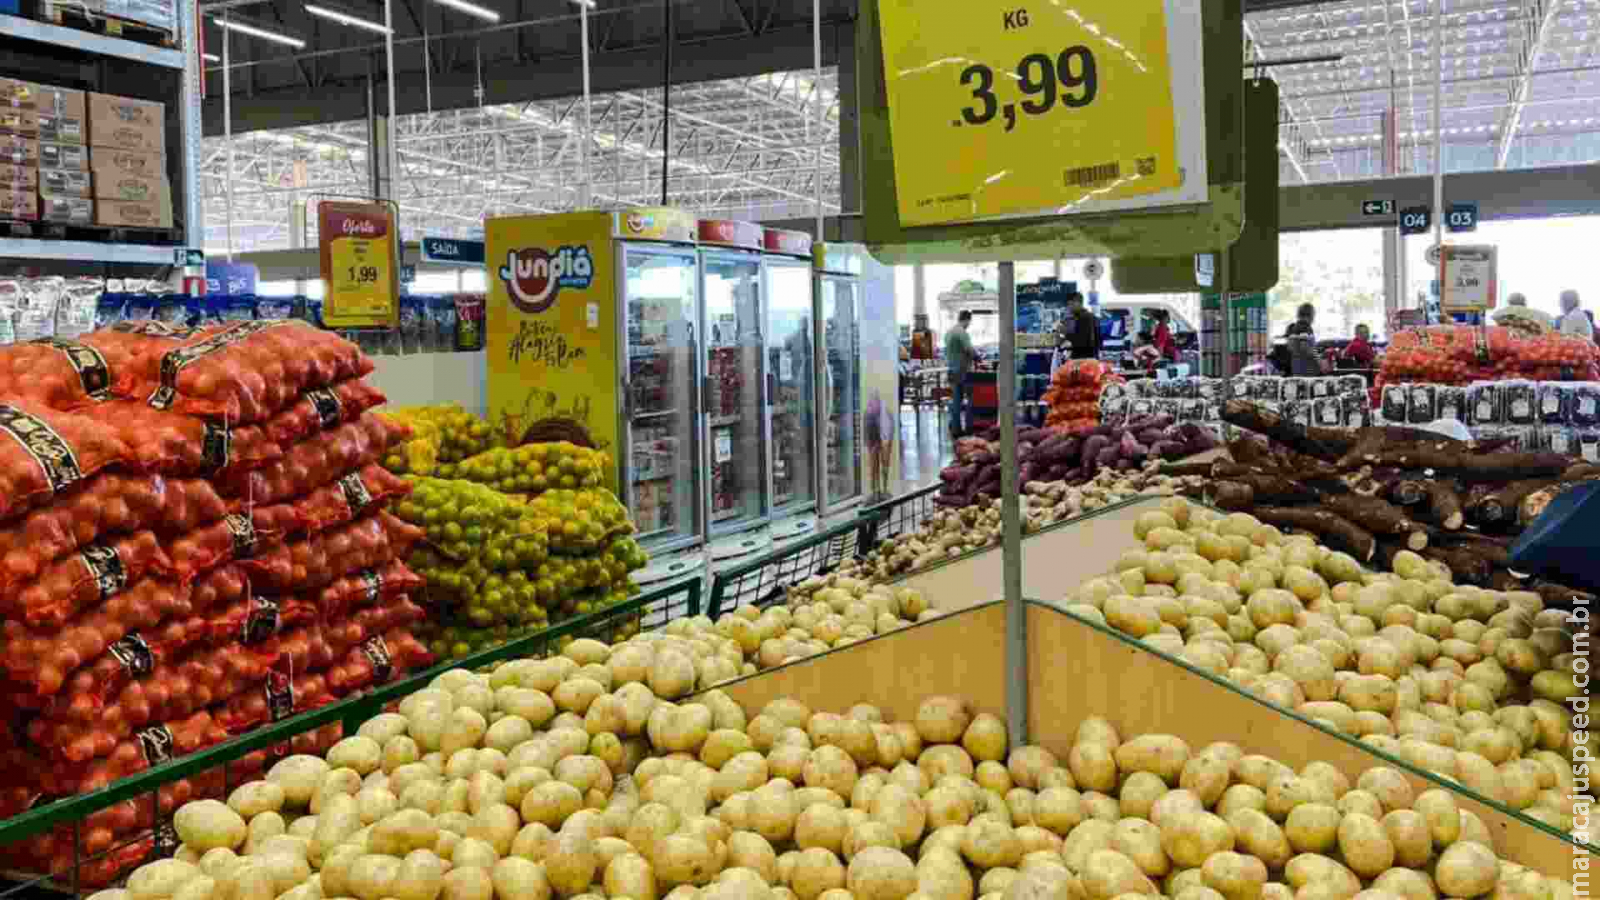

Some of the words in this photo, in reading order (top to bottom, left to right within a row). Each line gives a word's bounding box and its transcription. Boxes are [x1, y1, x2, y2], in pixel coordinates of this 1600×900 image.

[1003, 9, 1028, 30] KG
[960, 45, 1098, 133] 3,99
[342, 218, 375, 235] Oferta
[1404, 213, 1426, 227] 04
[1450, 212, 1472, 226] 03
[500, 247, 592, 282] Jundiá
[348, 266, 378, 283] 1,99
